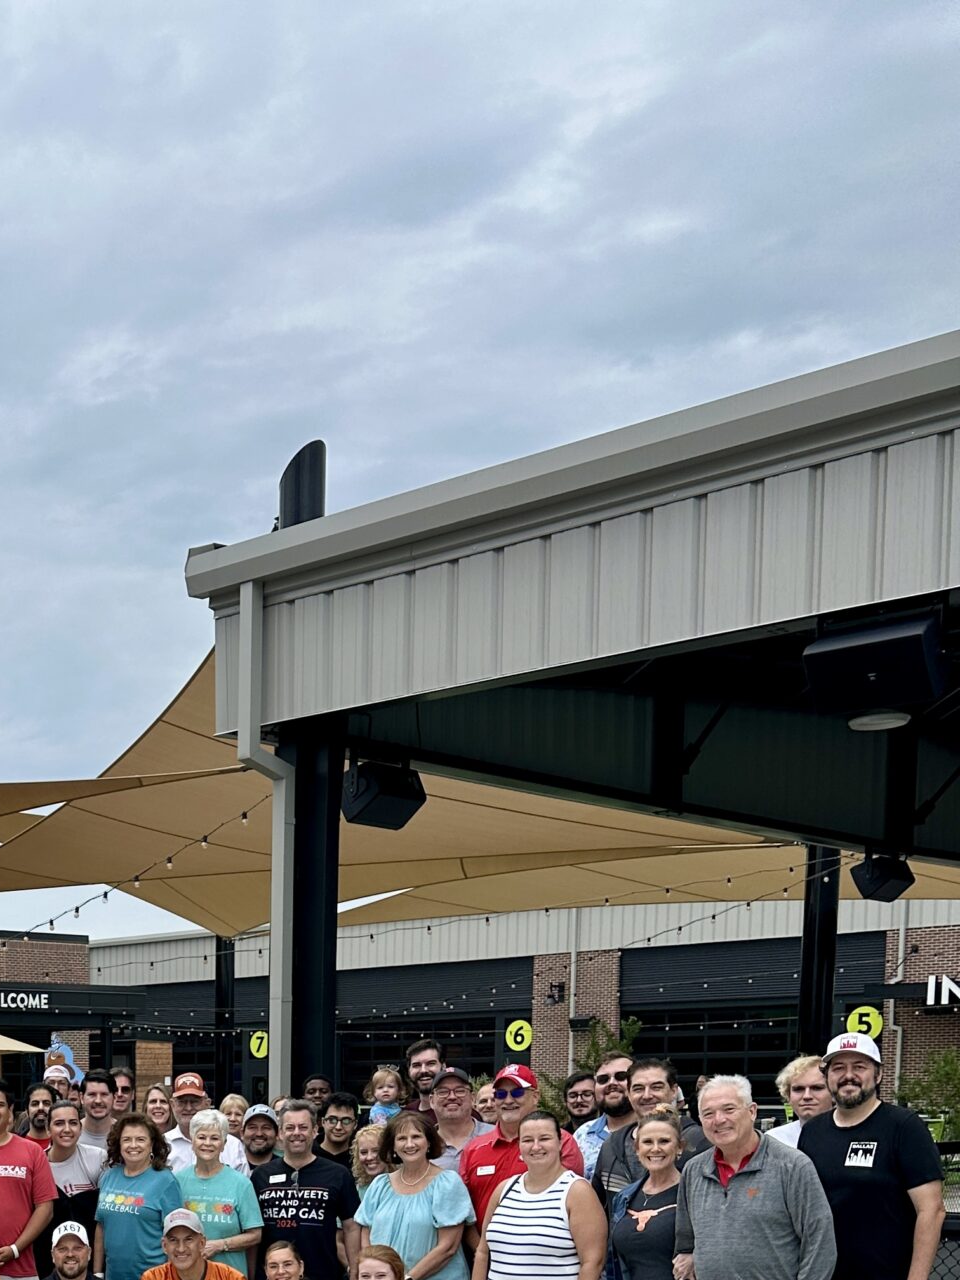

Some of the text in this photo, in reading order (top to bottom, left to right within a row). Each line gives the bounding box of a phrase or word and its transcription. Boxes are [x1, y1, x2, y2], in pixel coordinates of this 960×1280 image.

[858, 1012, 872, 1035] 5
[513, 1025, 525, 1046] 6
[255, 1035, 265, 1053] 7
[259, 1190, 286, 1200] MEAN
[280, 1199, 299, 1207] AND
[263, 1207, 326, 1220] CHEAP GAS
[276, 1220, 298, 1228] 2024
